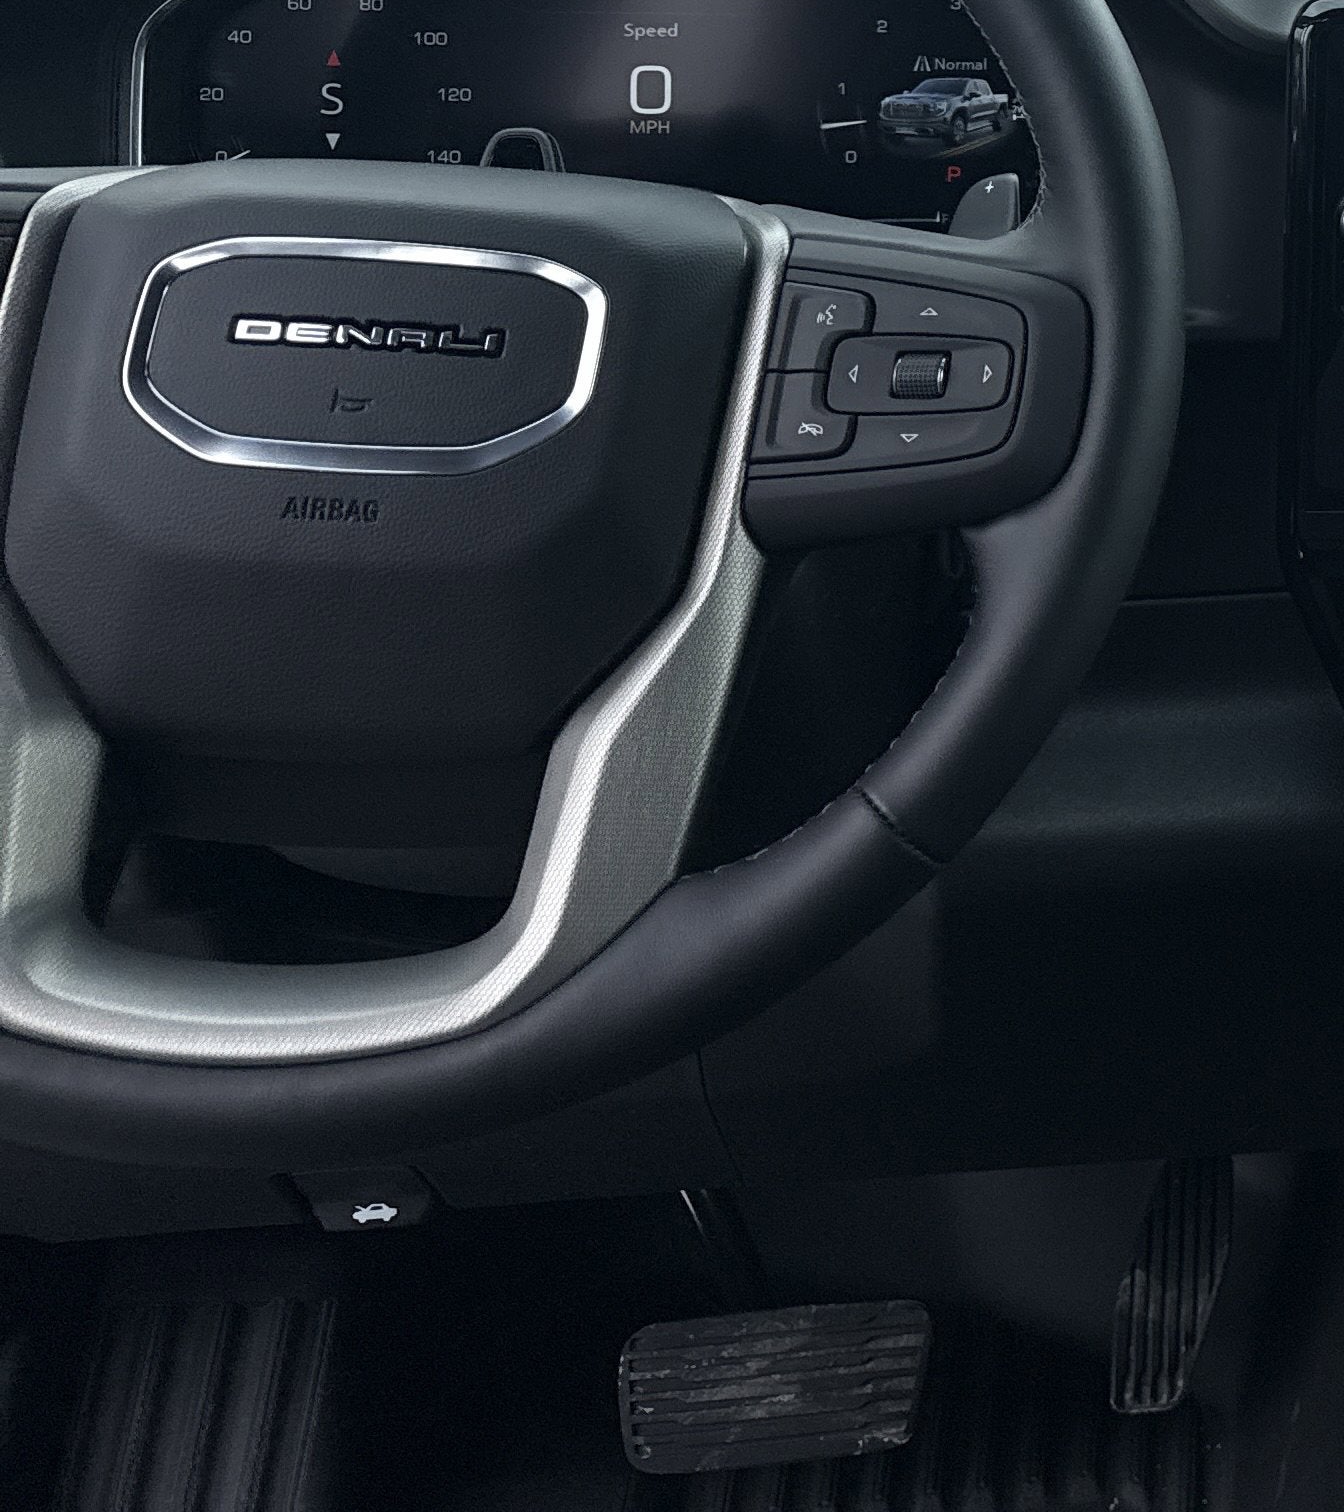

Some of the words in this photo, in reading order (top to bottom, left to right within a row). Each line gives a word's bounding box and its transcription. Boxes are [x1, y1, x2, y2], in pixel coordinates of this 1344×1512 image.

[624, 22, 679, 41] Speed
[876, 20, 888, 34] 2
[227, 30, 252, 44] 40
[414, 31, 448, 46] 100
[934, 57, 988, 71] Normal
[200, 88, 224, 102] 20
[439, 88, 472, 102] 120
[630, 64, 672, 115] 0
[838, 82, 846, 95] 1
[320, 82, 344, 116] S
[629, 119, 671, 134] MPH
[427, 150, 462, 164] 140
[845, 150, 858, 164] 0
[946, 166, 962, 182] P
[232, 317, 502, 353] DENALI
[280, 495, 381, 523] AIRBAG
